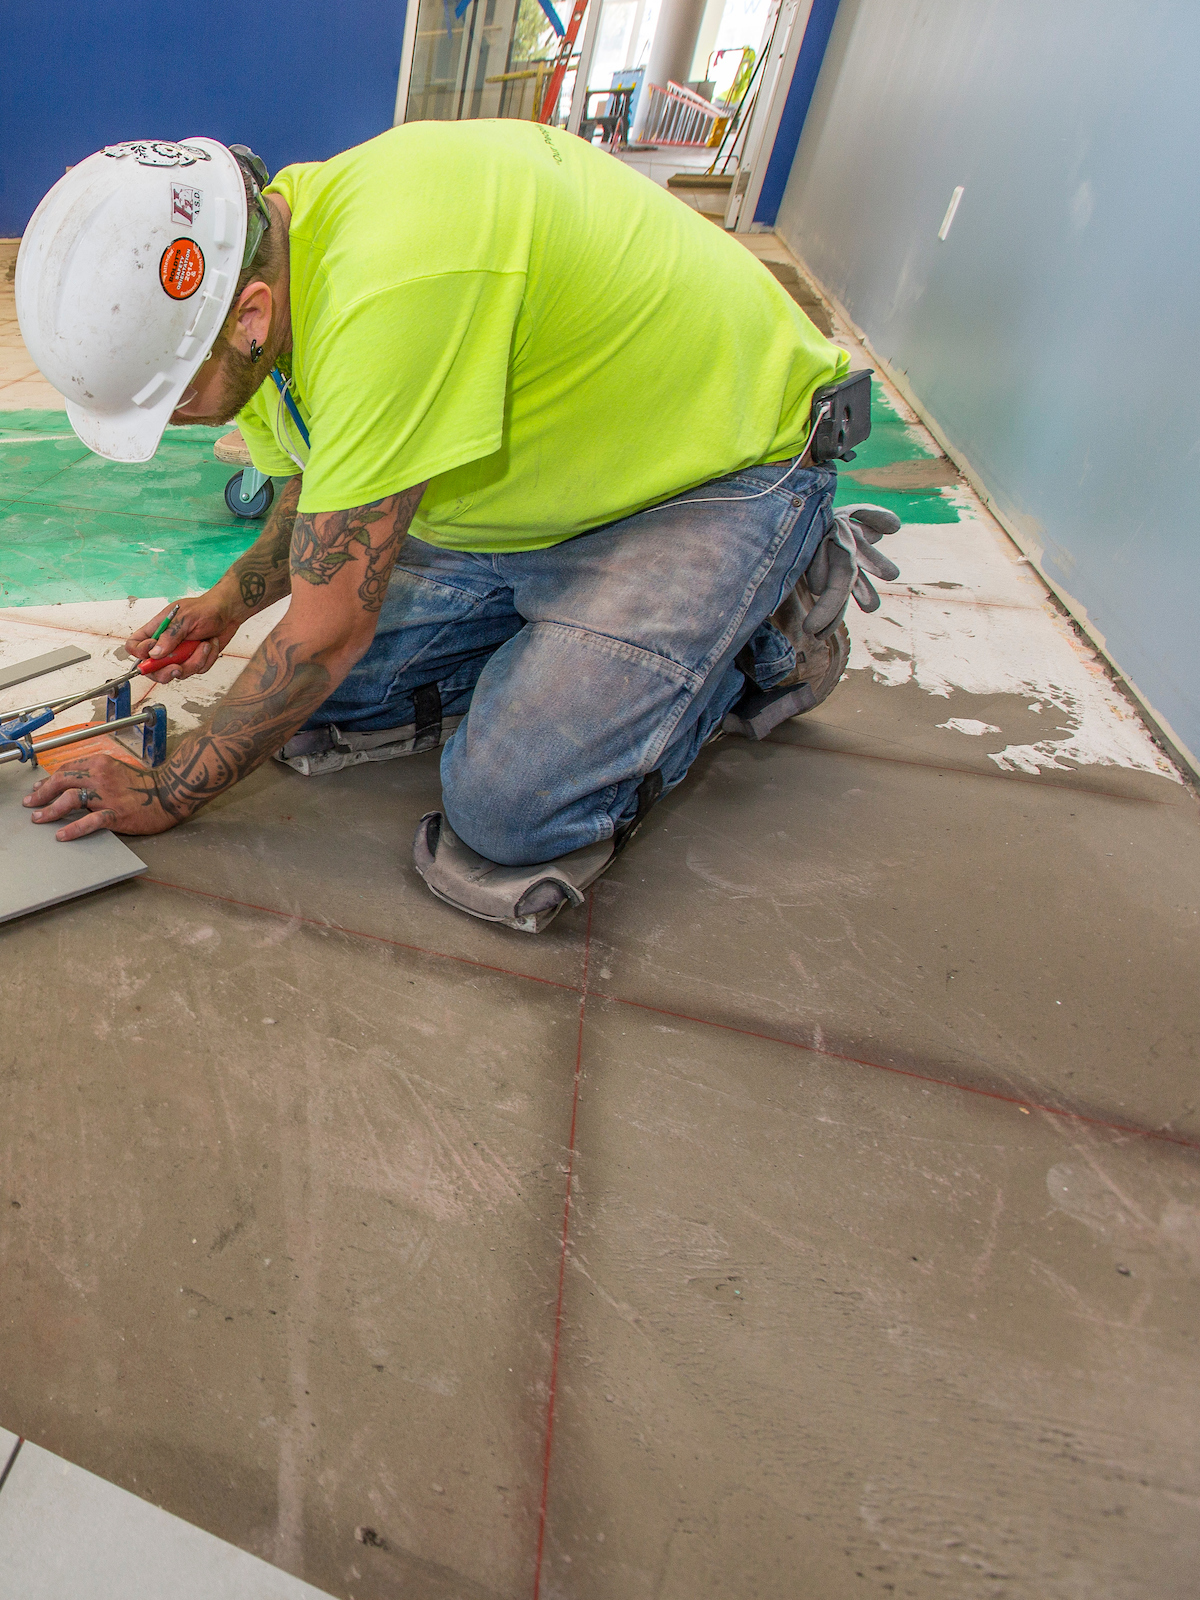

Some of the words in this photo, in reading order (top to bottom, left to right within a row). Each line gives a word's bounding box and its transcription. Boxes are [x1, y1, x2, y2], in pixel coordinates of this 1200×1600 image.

[169, 249, 181, 282] BOLDT'S
[175, 255, 184, 280] SAFETY
[176, 248, 191, 290] ORIENTATION
[185, 261, 193, 282] 2014
[190, 270, 197, 278] &
